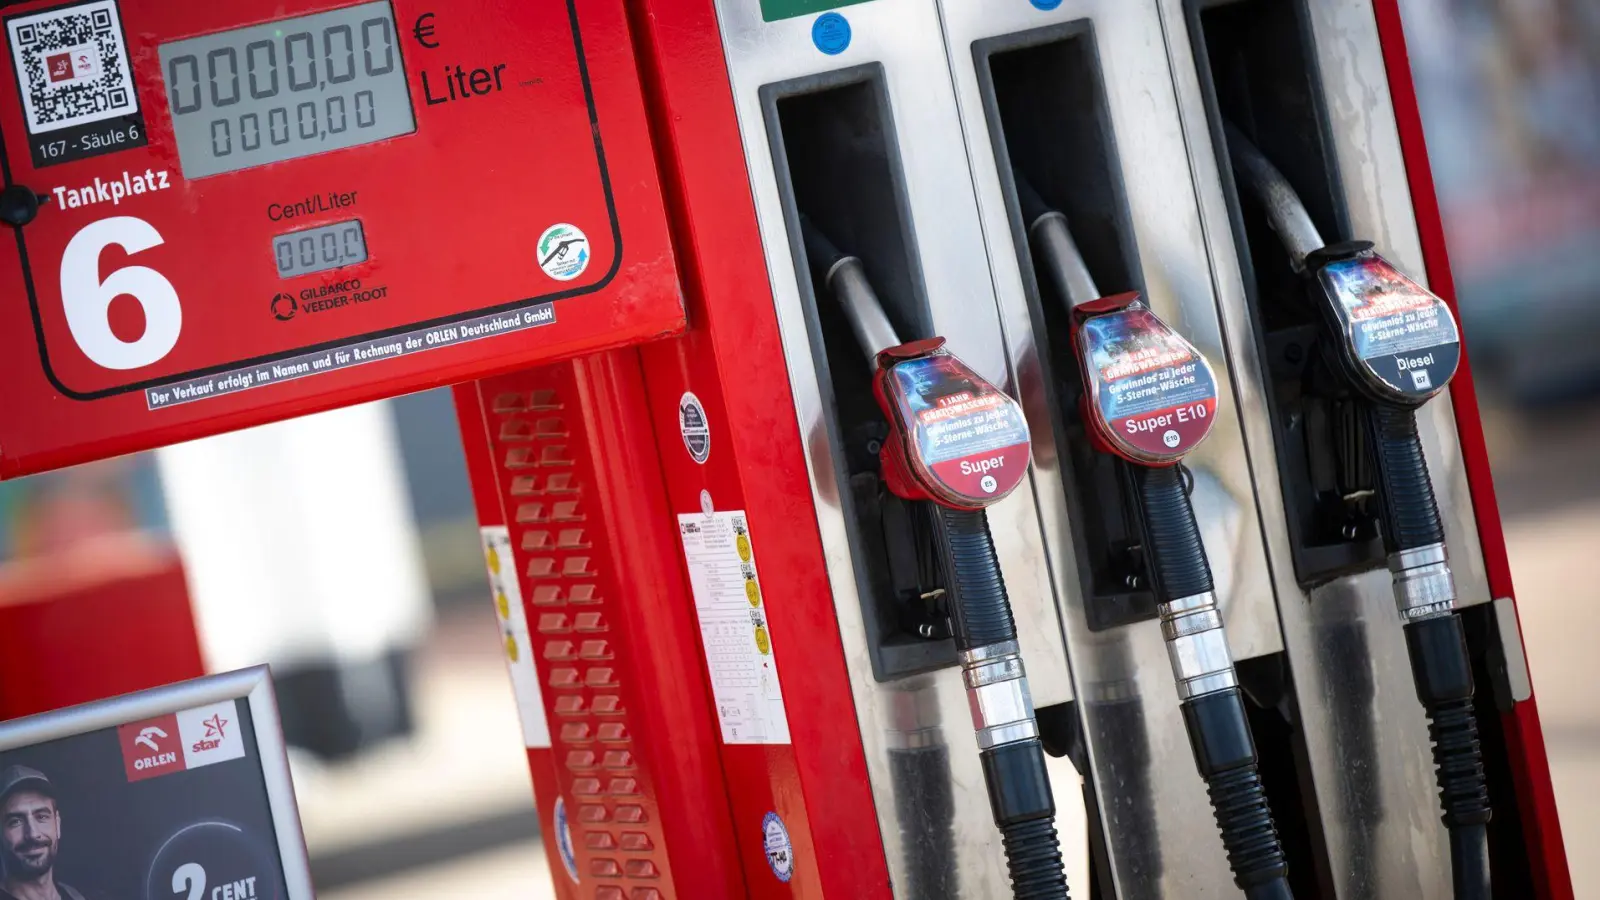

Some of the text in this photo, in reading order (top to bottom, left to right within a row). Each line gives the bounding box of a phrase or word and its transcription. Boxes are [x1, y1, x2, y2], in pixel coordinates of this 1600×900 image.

[413, 13, 439, 48] €
[421, 64, 506, 105] Liter
[39, 141, 66, 159] 167
[81, 129, 126, 150] Säule
[128, 125, 139, 141] 6
[53, 168, 170, 210] Tankplatz
[267, 191, 358, 221] Cent/Liter
[60, 216, 182, 370] 6
[300, 279, 361, 300] GILBARCO
[151, 307, 553, 405] Der Verkauf erfolgt im Namen und für Rechnung der ORLEN Deutschland GmbH
[1397, 353, 1434, 371] Diesel
[1108, 363, 1196, 394] Gewinnlos zu jeder
[1416, 376, 1425, 384] B7
[974, 415, 984, 424] zu
[1126, 404, 1207, 434] Super E10
[1165, 434, 1178, 442] E10
[960, 455, 1005, 475] Super
[985, 480, 993, 488] E5
[192, 737, 221, 753] star
[134, 752, 177, 771] ORLEN
[172, 862, 256, 900] 2 CENT
